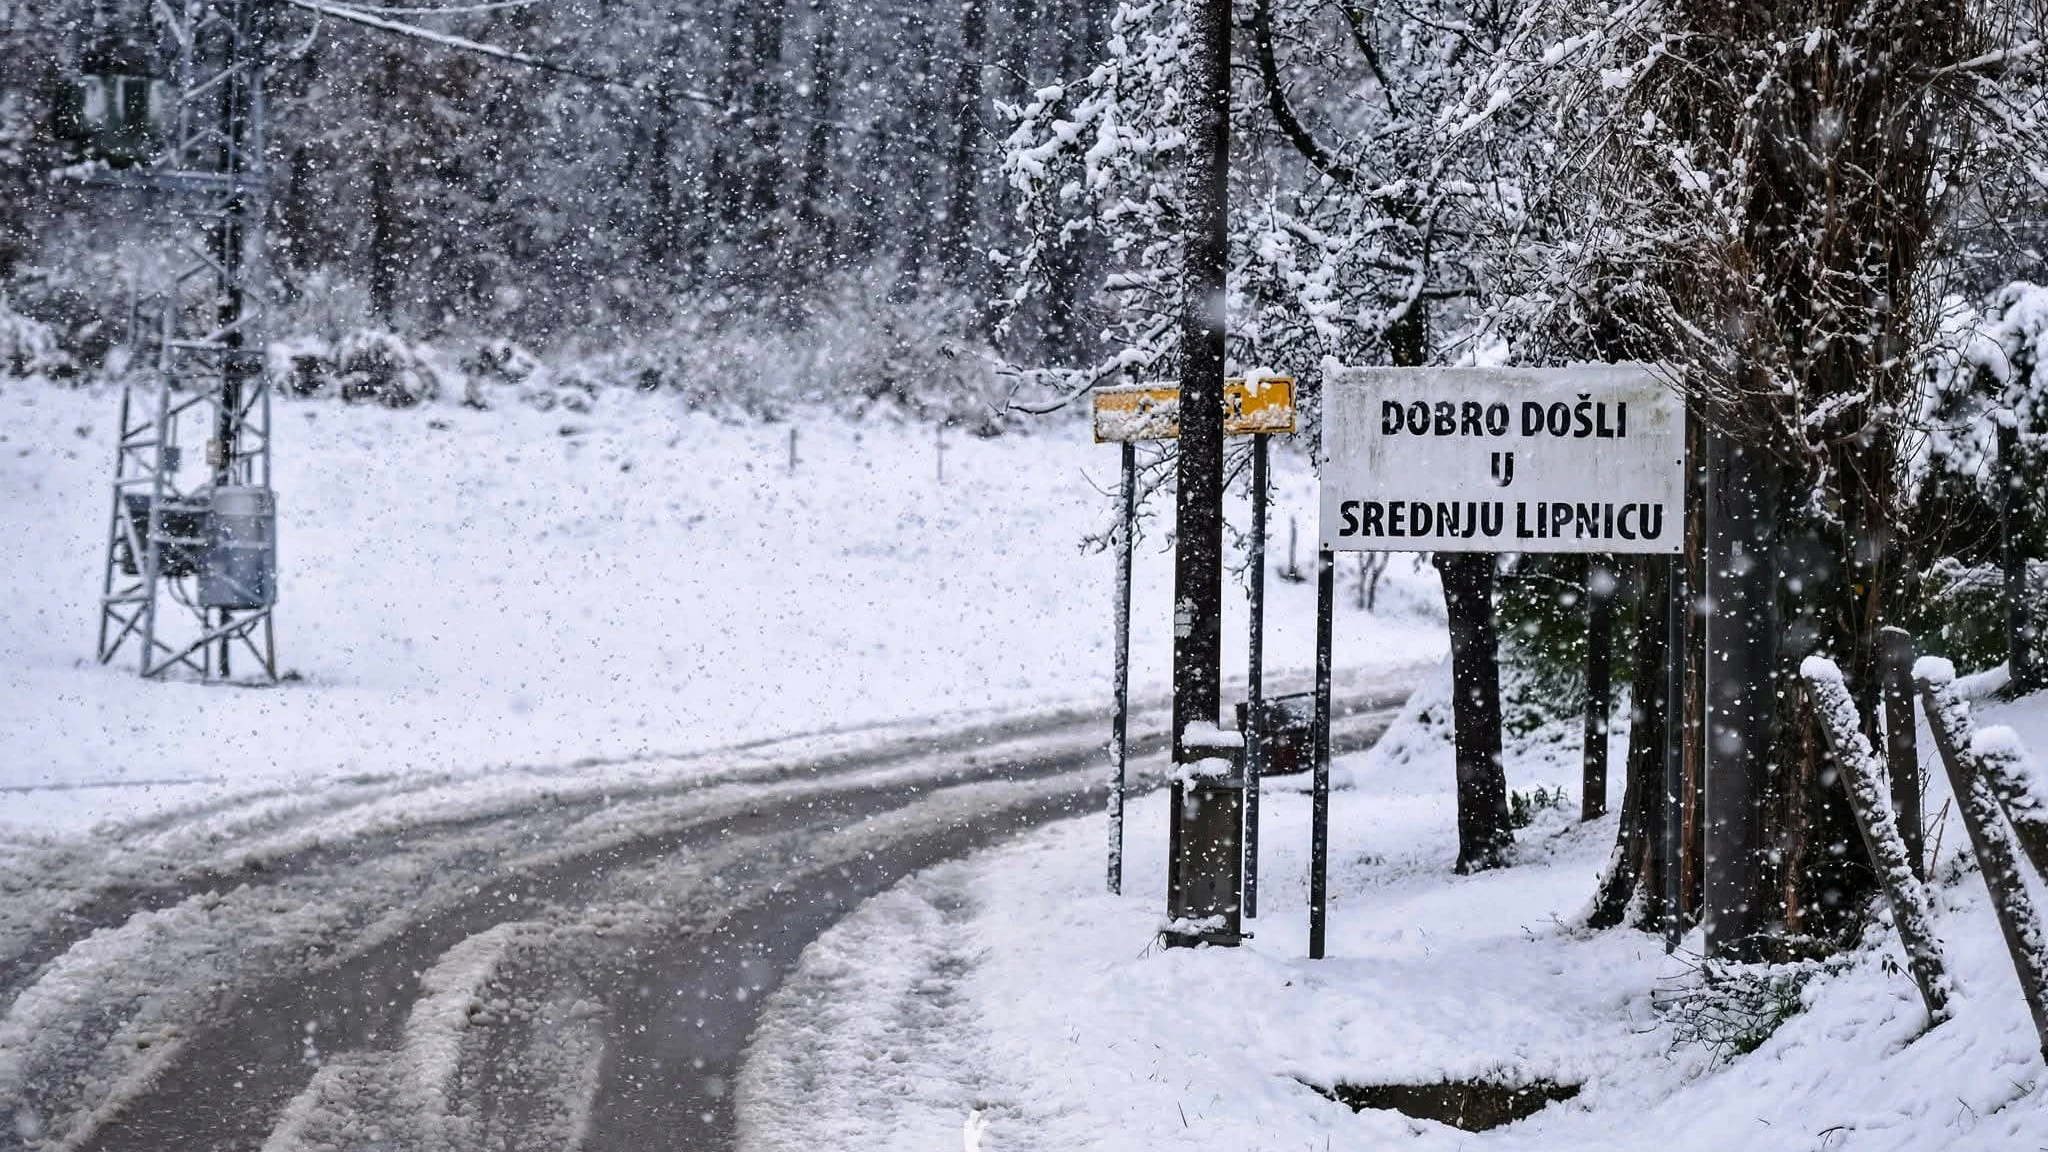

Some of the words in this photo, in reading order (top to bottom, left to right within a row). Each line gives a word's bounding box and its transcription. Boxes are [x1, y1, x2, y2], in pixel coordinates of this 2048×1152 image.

[1381, 400, 1510, 437] DOBRO
[1521, 393, 1627, 438] DOŠLI
[1490, 452, 1515, 488] U
[1339, 500, 1504, 538] SREDNJU
[1516, 502, 1663, 540] LIPNICU
